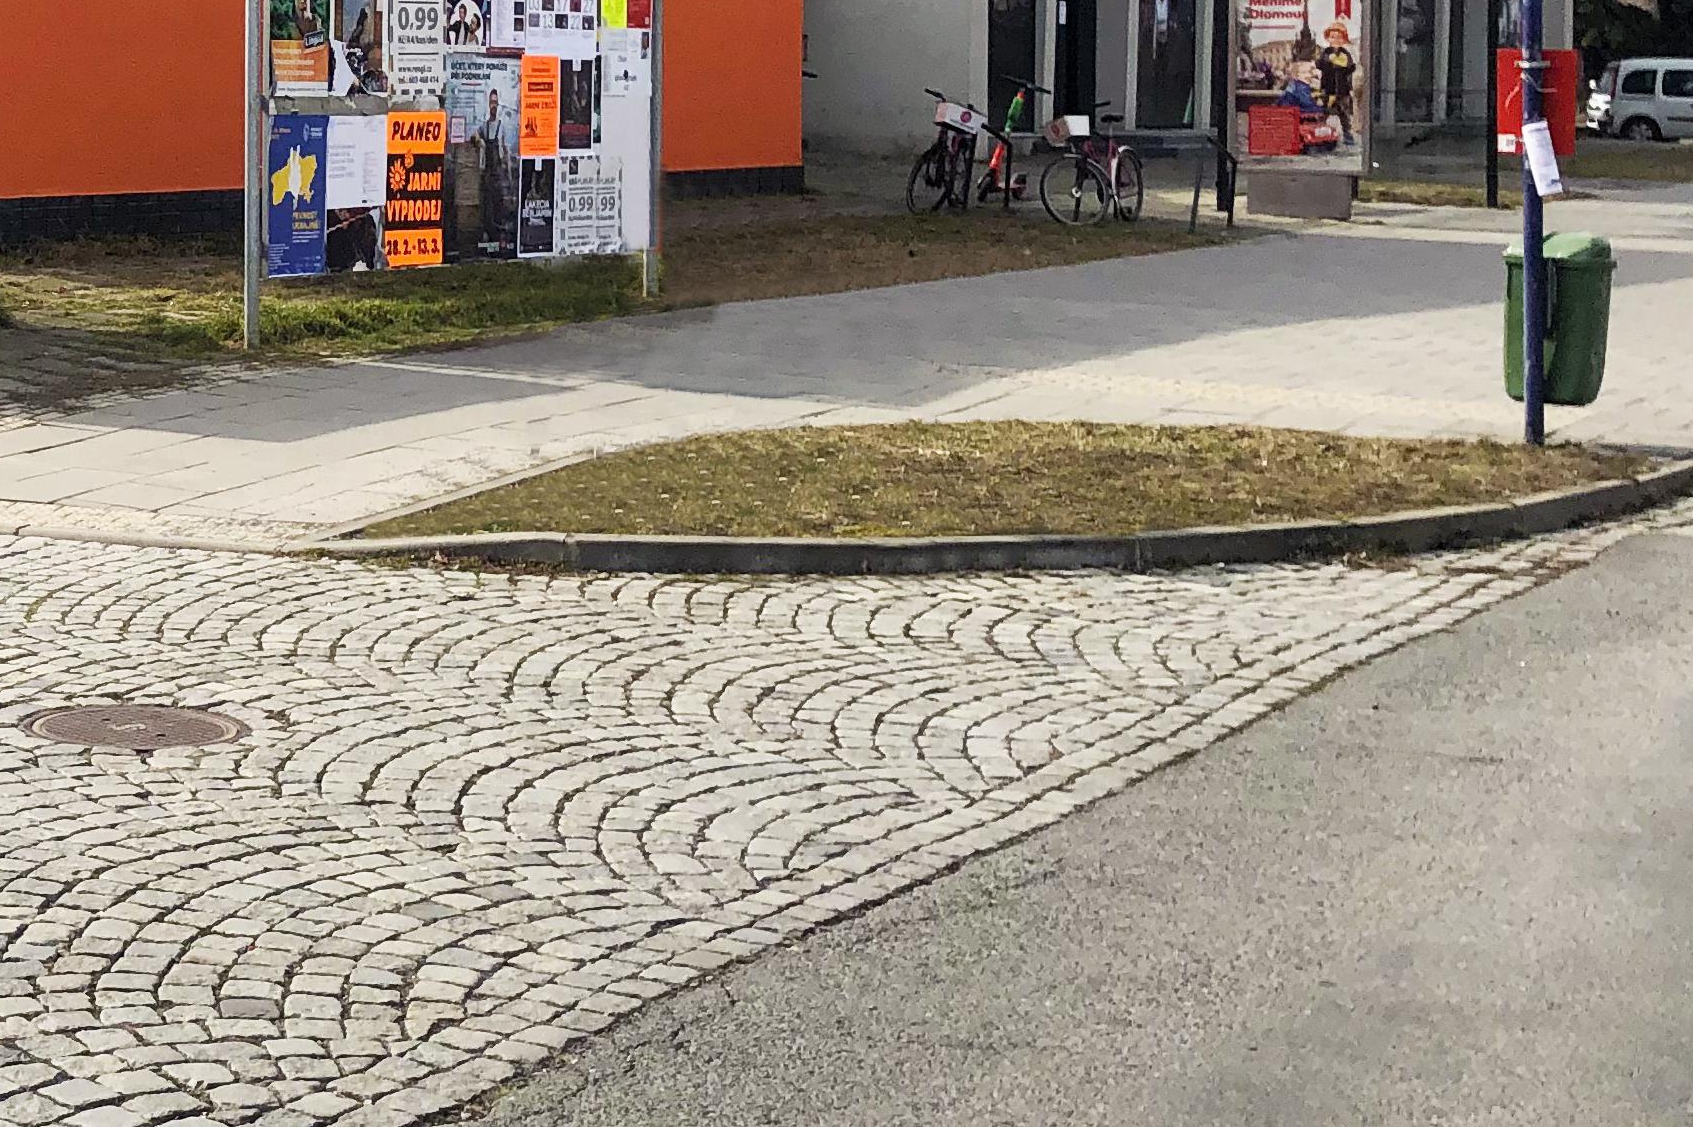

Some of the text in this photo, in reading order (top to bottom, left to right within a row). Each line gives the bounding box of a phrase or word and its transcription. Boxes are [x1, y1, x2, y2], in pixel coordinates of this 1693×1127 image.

[391, 121, 442, 141] PLANEO
[407, 166, 442, 191] JARNÍ
[386, 192, 442, 222] VÝPRODEJ
[386, 239, 401, 256] 28.
